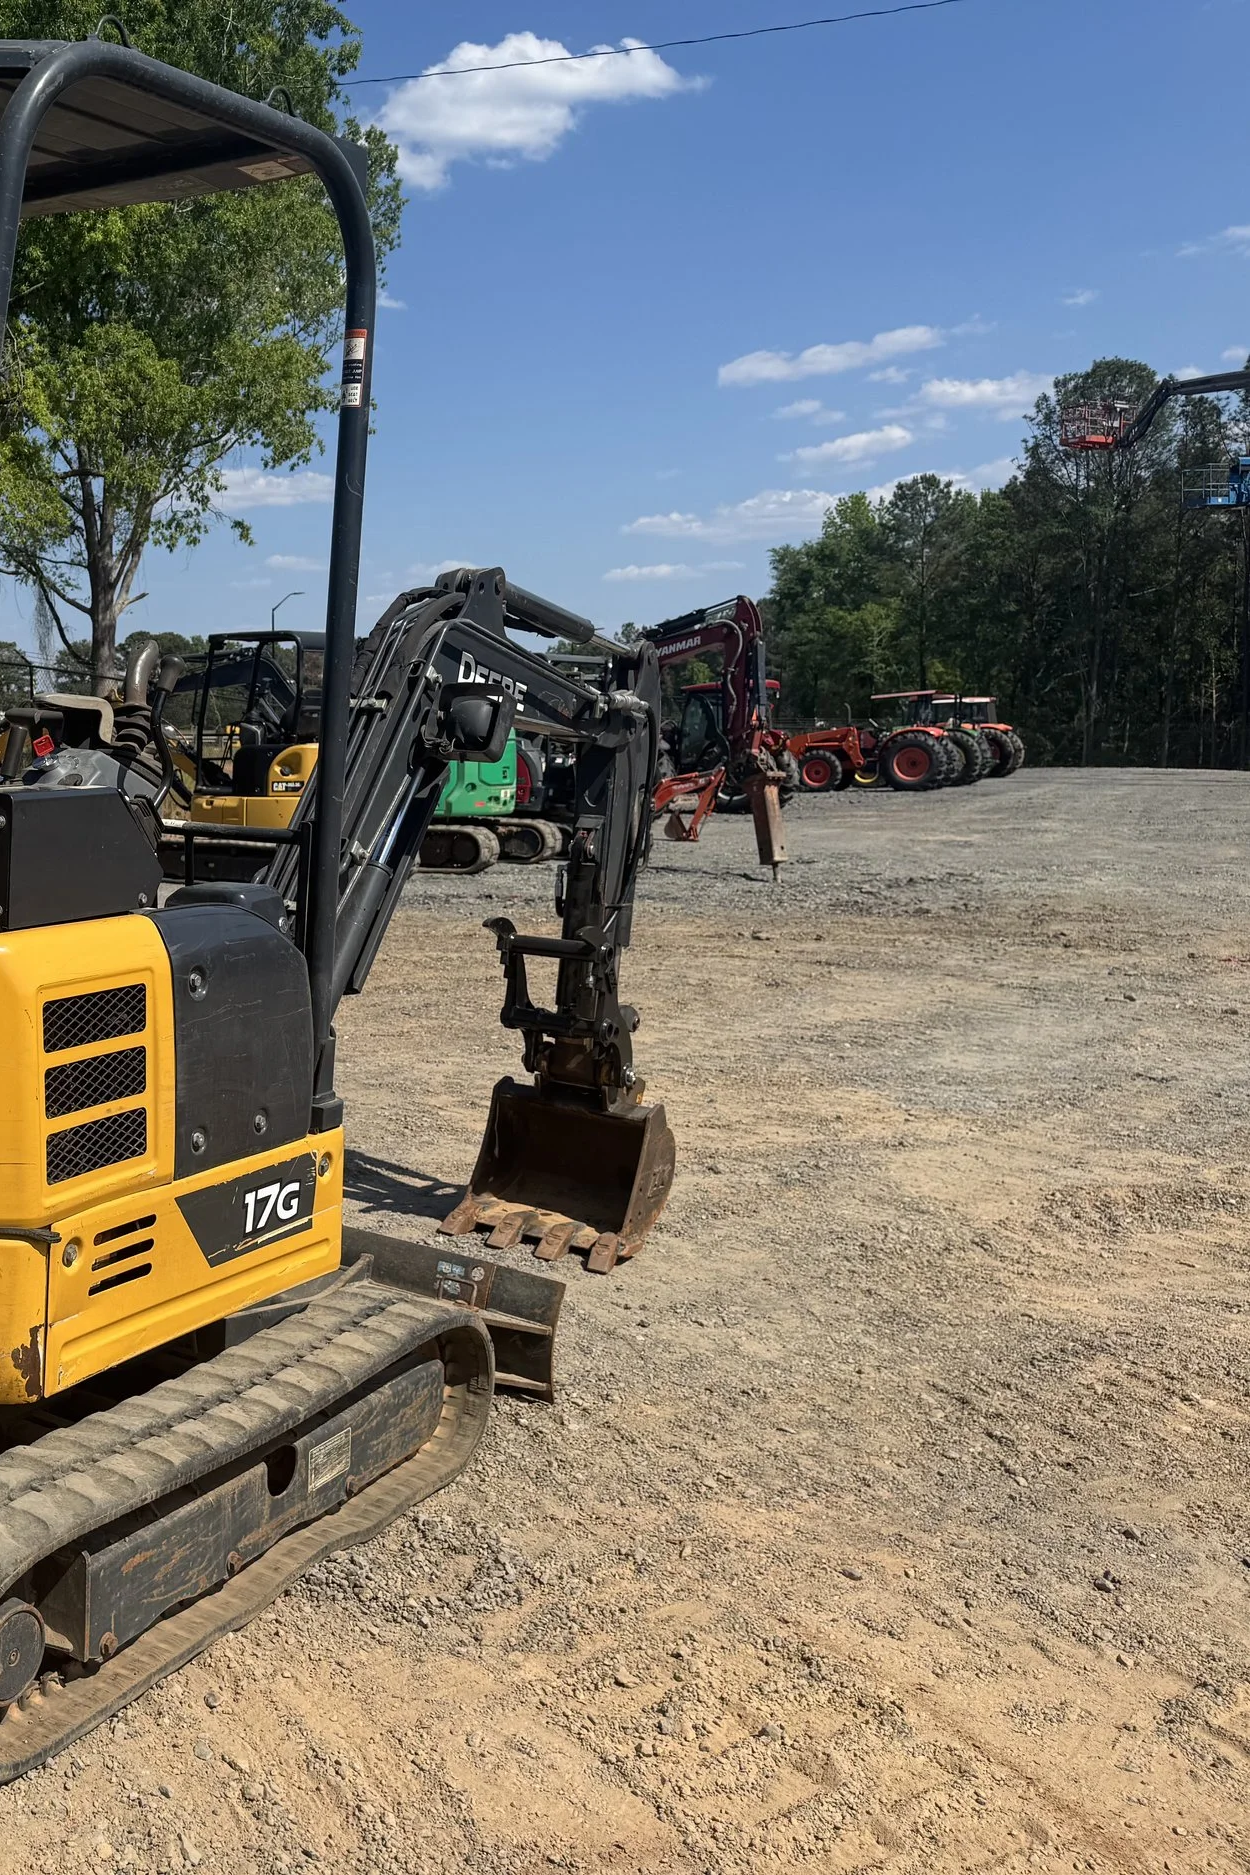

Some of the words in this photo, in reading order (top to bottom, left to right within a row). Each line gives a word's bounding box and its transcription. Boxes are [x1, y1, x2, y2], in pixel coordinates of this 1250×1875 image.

[655, 635, 701, 658] YANMAR
[273, 782, 286, 792] CAT
[244, 1182, 300, 1234] 17G
